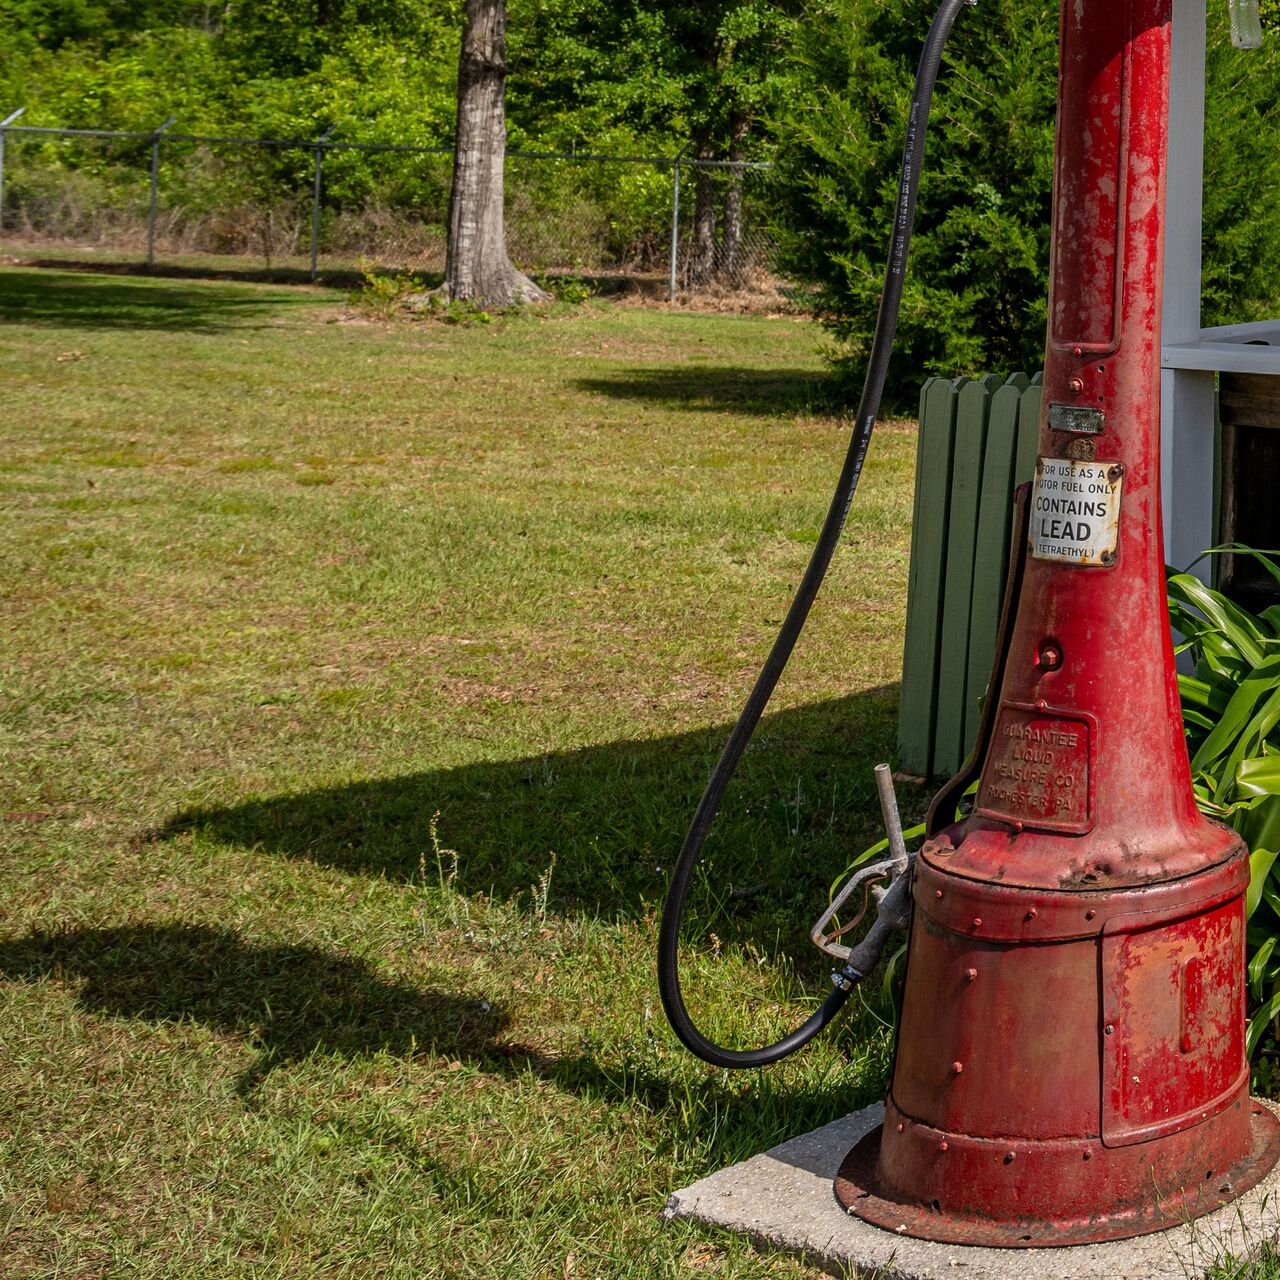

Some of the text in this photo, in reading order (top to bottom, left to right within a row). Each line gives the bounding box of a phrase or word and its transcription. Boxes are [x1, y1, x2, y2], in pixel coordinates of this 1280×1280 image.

[1058, 466, 1076, 477] USE
[1079, 468, 1093, 478] AS
[1097, 470, 1105, 479] A
[1061, 481, 1084, 492] FUEL
[1088, 483, 1117, 494] ONLY
[1036, 496, 1107, 517] CONTAINS
[1040, 518, 1091, 541] LEAD
[1036, 543, 1095, 558] (TETRAETHYL)
[1003, 722, 1079, 747] GUARANTEE
[1013, 745, 1054, 765] LIQUID
[993, 762, 1048, 785] MEASURE
